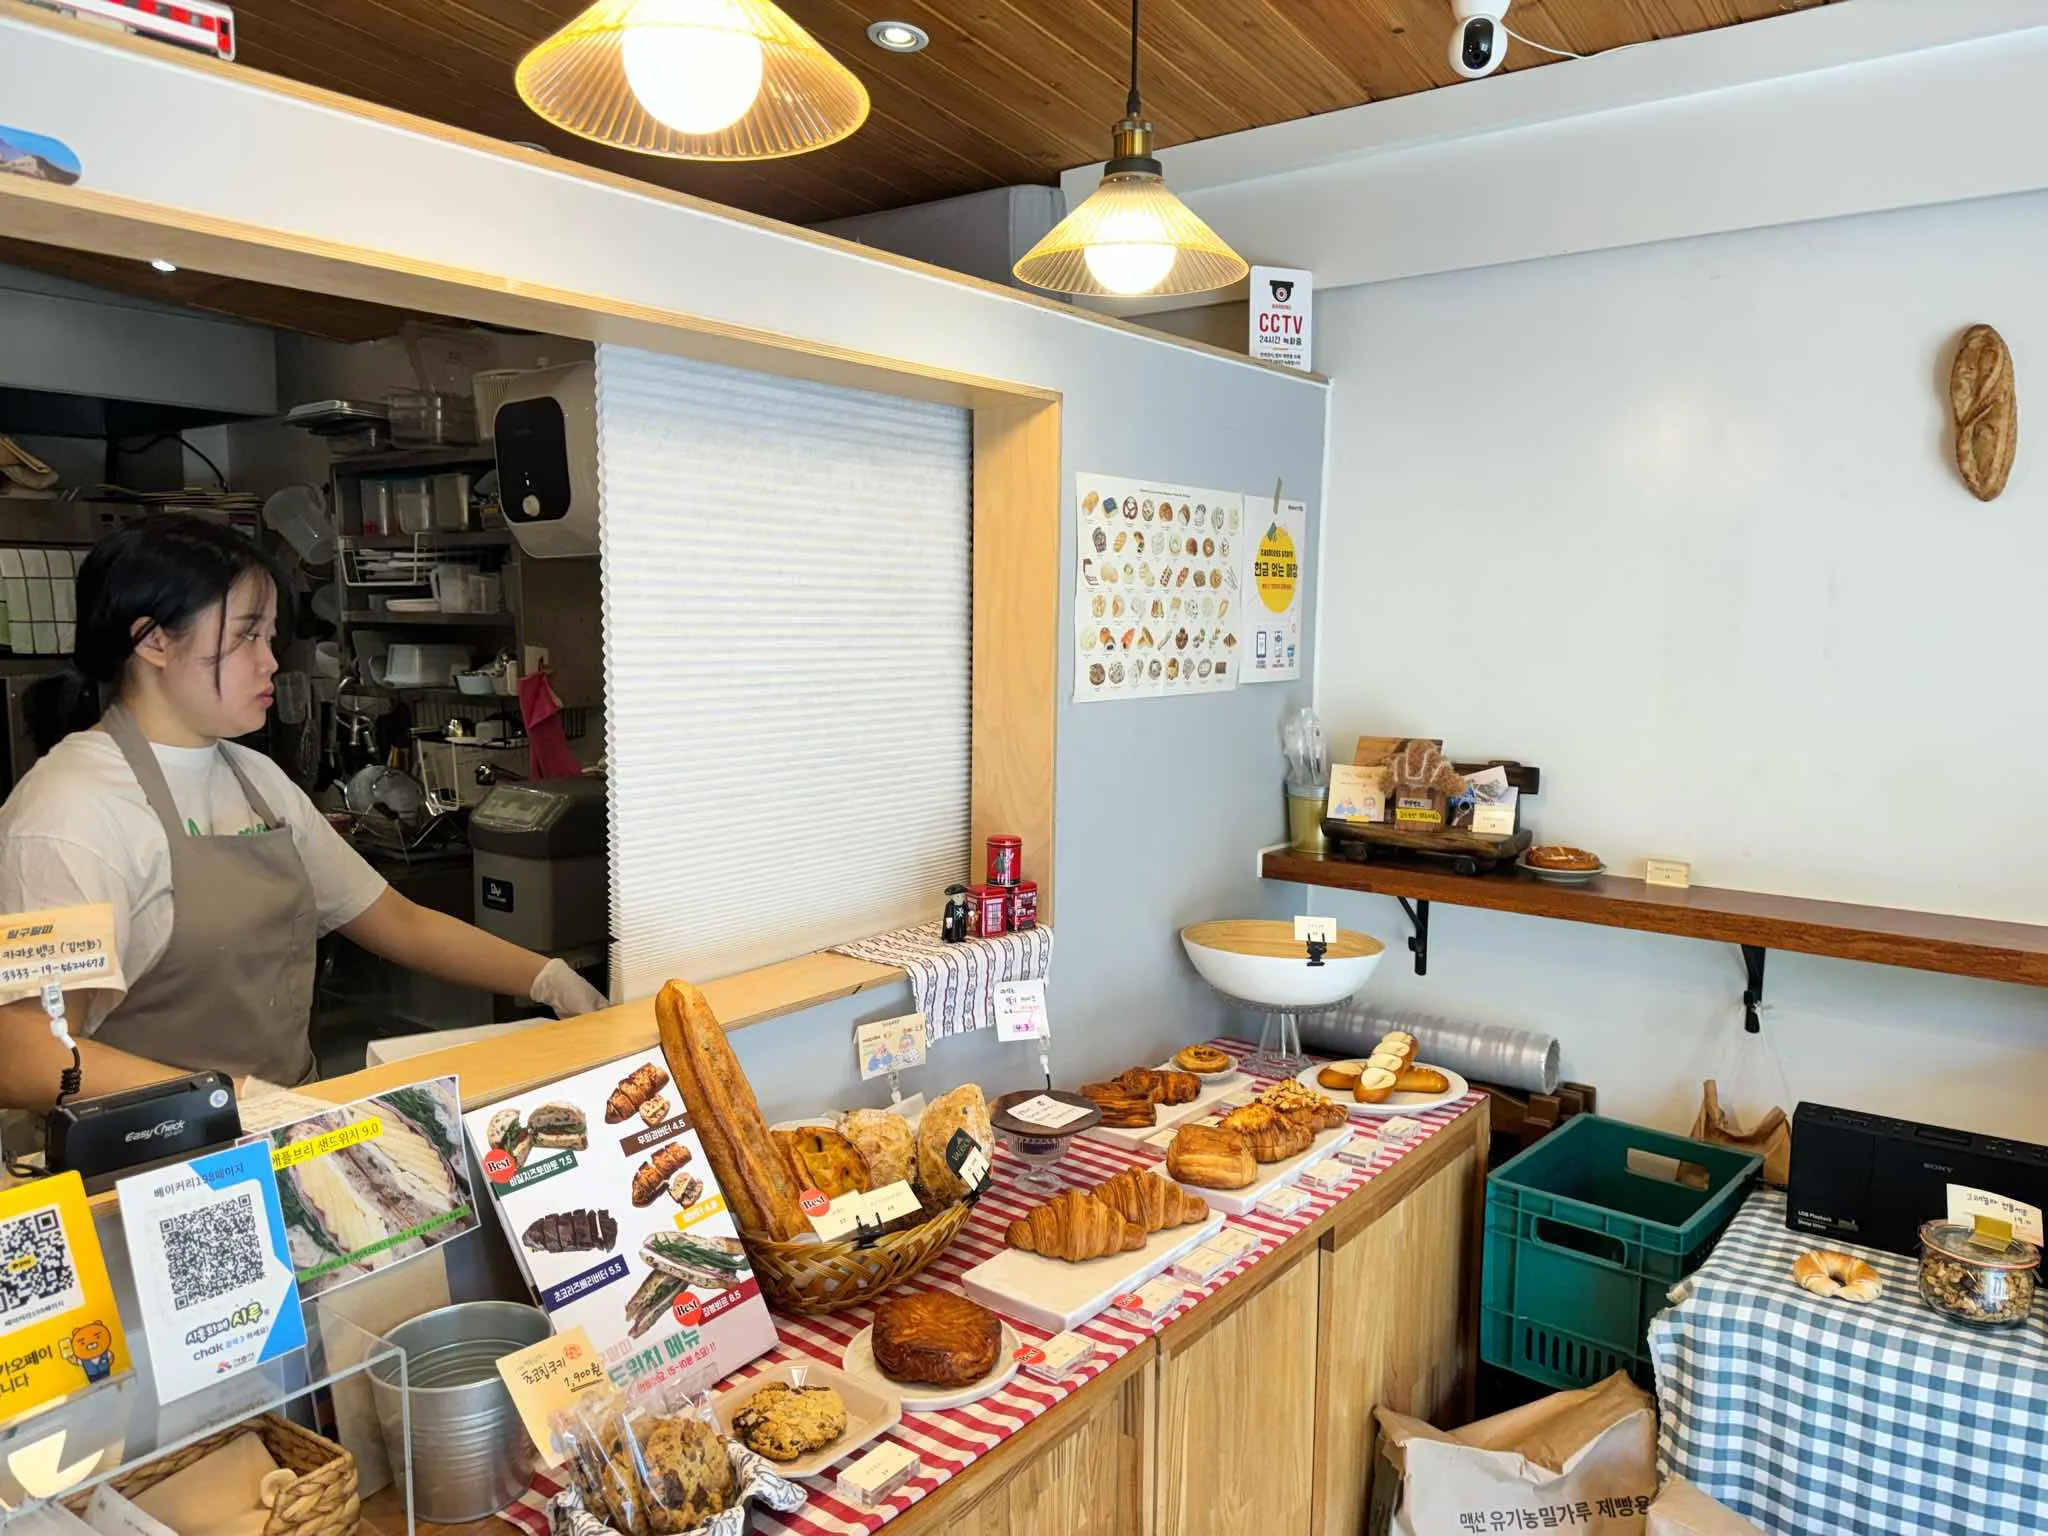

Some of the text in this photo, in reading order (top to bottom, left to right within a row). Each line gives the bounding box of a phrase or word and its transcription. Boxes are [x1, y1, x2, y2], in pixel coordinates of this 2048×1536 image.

[1259, 313, 1303, 335] CCTV
[1254, 561, 1269, 577] 현금
[1271, 562, 1285, 578] 없는
[318, 1129, 361, 1155] 샌드위치
[362, 1121, 380, 1140] 9.0
[488, 1157, 512, 1173] Best
[559, 1154, 574, 1168] 7.5
[1923, 1161, 1955, 1174] SONY
[153, 1163, 246, 1199] 베이커리198페이지
[802, 1195, 827, 1210] Best
[607, 1262, 623, 1277] 5.5
[676, 1299, 700, 1317] Best
[193, 1340, 224, 1362] chak
[664, 1328, 701, 1359] 메뉴
[522, 1357, 567, 1386] 초코칩쿠키
[563, 1362, 604, 1389] 1,900원
[0, 1373, 30, 1398] 니다
[1459, 1495, 1651, 1535] 맥선 유기농밀가루 제빵용
